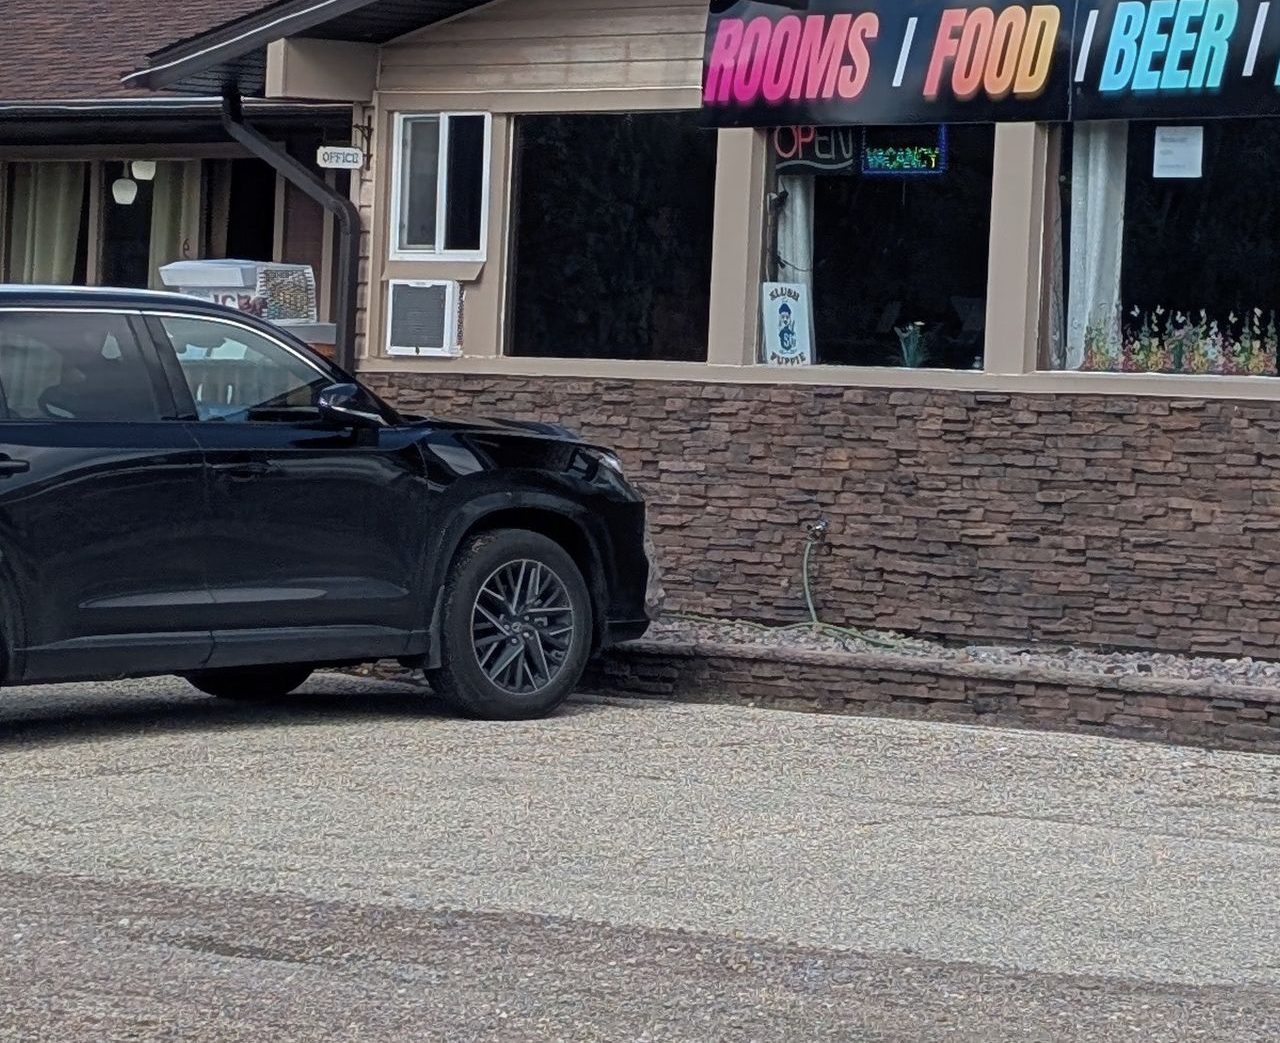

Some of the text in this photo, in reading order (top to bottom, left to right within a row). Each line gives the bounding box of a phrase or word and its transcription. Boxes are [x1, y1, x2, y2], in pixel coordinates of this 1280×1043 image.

[704, 12, 880, 101] ROOMS
[923, 5, 1061, 95] FOOD
[322, 151, 359, 164] OFFICE
[774, 126, 853, 159] OPEN
